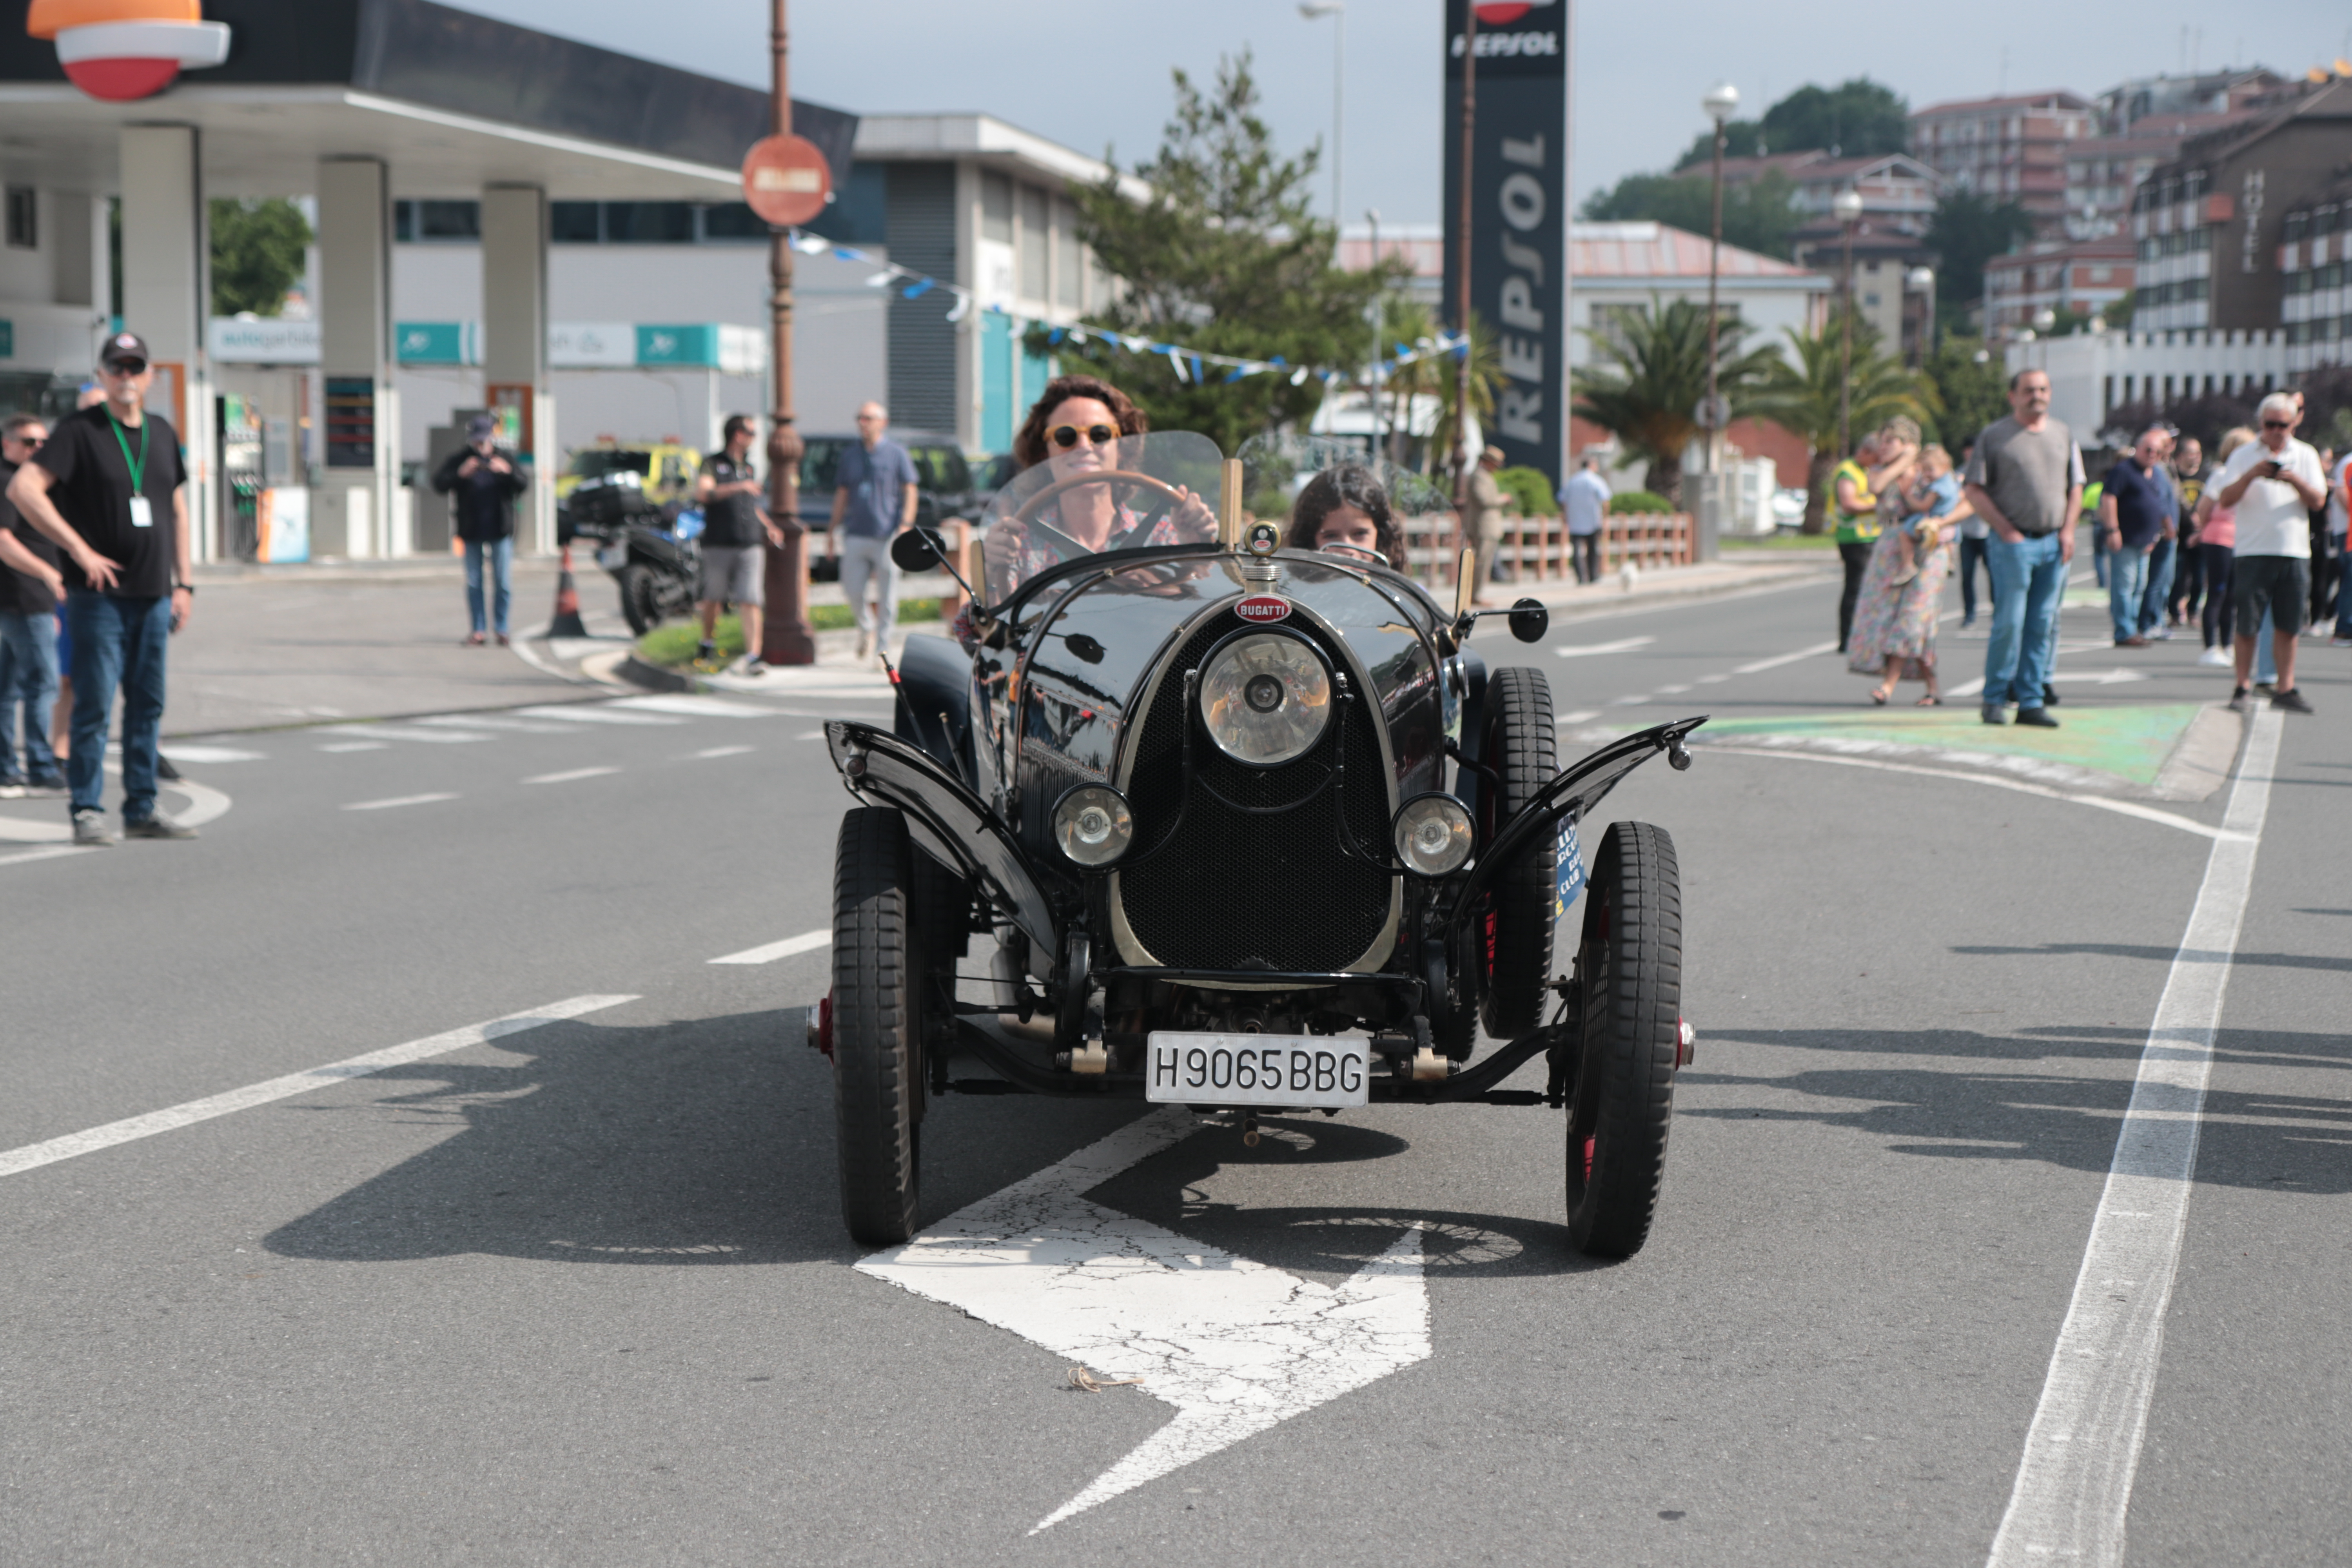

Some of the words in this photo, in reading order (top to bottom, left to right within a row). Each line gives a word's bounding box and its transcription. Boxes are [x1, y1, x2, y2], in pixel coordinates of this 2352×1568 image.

[2242, 169, 2264, 274] HOTEL
[1499, 132, 1546, 444] REPSOL
[1240, 605, 1285, 615] BUGATTI
[1560, 868, 1580, 895] CLUB
